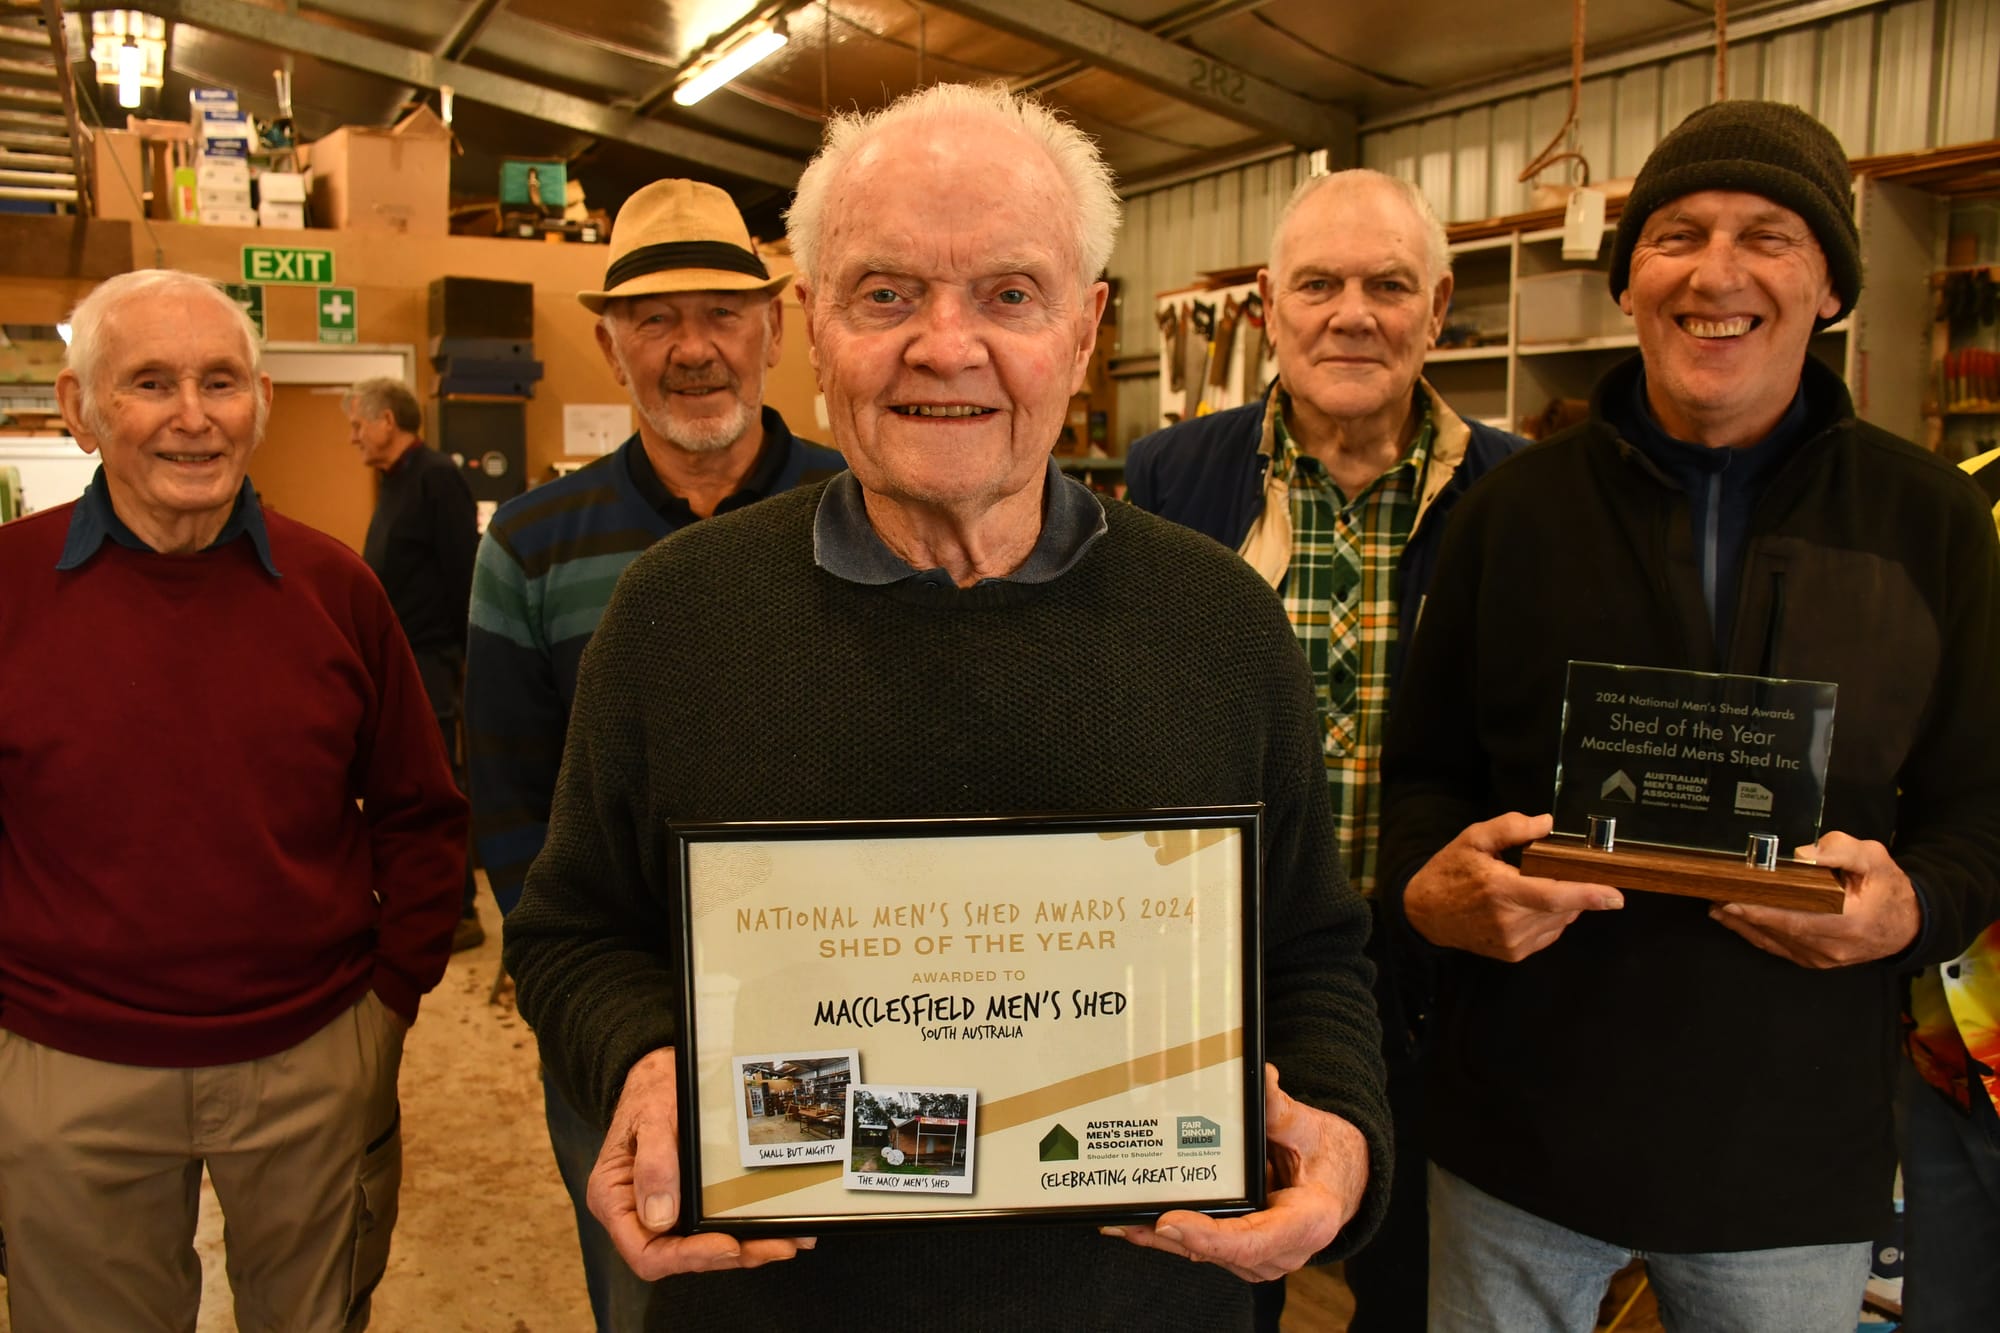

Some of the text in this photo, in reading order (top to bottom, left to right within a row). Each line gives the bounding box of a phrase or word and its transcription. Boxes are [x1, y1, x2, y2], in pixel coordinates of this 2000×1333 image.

[1190, 59, 1245, 104] 2R2
[252, 251, 325, 280] EXIT
[1596, 692, 1795, 720] 2024 National Men's Shed Awards
[1610, 713, 1776, 745] Shed of the Year
[1581, 736, 1800, 770] Macclesfield Mens Shed Inc
[1645, 771, 1708, 785] AUSTRALIAN
[1642, 780, 1703, 793] MEN'S SHED
[1642, 789, 1710, 803] ASSOCIATION
[737, 897, 1196, 933] NATIONAL MEN'S SHED AWARDS 2024
[819, 930, 1116, 958] SHED OF THE YEAR
[912, 969, 1025, 984] AWARDED TO
[814, 989, 1127, 1028] MACCLESFIELD MEN'S SHED
[921, 1024, 1023, 1041] SOUTH AUSTRALIA
[1087, 1119, 1158, 1129] AUSTRALIAN
[1182, 1121, 1201, 1129] FAIR
[1086, 1129, 1153, 1139] MEN'S SHED
[1182, 1128, 1216, 1137] DINKUM
[1087, 1139, 1163, 1150] ASSOCIATION
[1182, 1136, 1213, 1145] BUILDS
[759, 1144, 835, 1160] SMALL BUT MIGHTY
[1087, 1152, 1119, 1160] Shoulder
[857, 1175, 950, 1188] THE MACCY MEN'S SHED
[1041, 1164, 1217, 1190] CELEBRATING GREAT SHEDS
